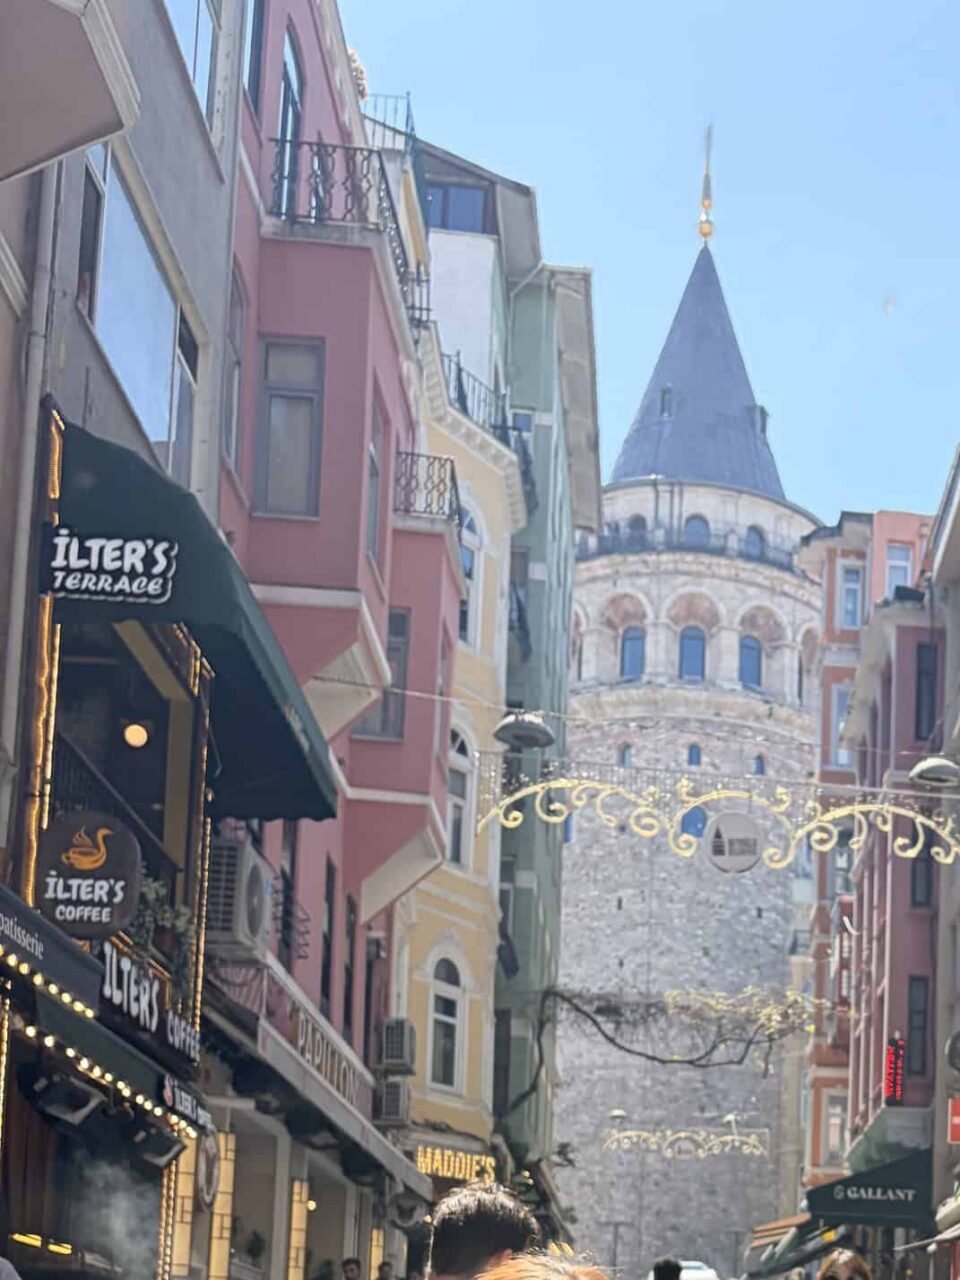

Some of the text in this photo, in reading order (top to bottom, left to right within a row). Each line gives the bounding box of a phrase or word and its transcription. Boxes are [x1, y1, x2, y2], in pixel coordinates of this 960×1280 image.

[51, 528, 170, 575] İLTER'S
[53, 571, 164, 595] TERRACE
[44, 870, 126, 903] İLTER'S
[55, 904, 112, 923] COFFEE
[167, 1009, 200, 1062] COFFEE
[417, 1144, 496, 1184] MADDIE'S
[846, 1185, 917, 1202] GALLANT
